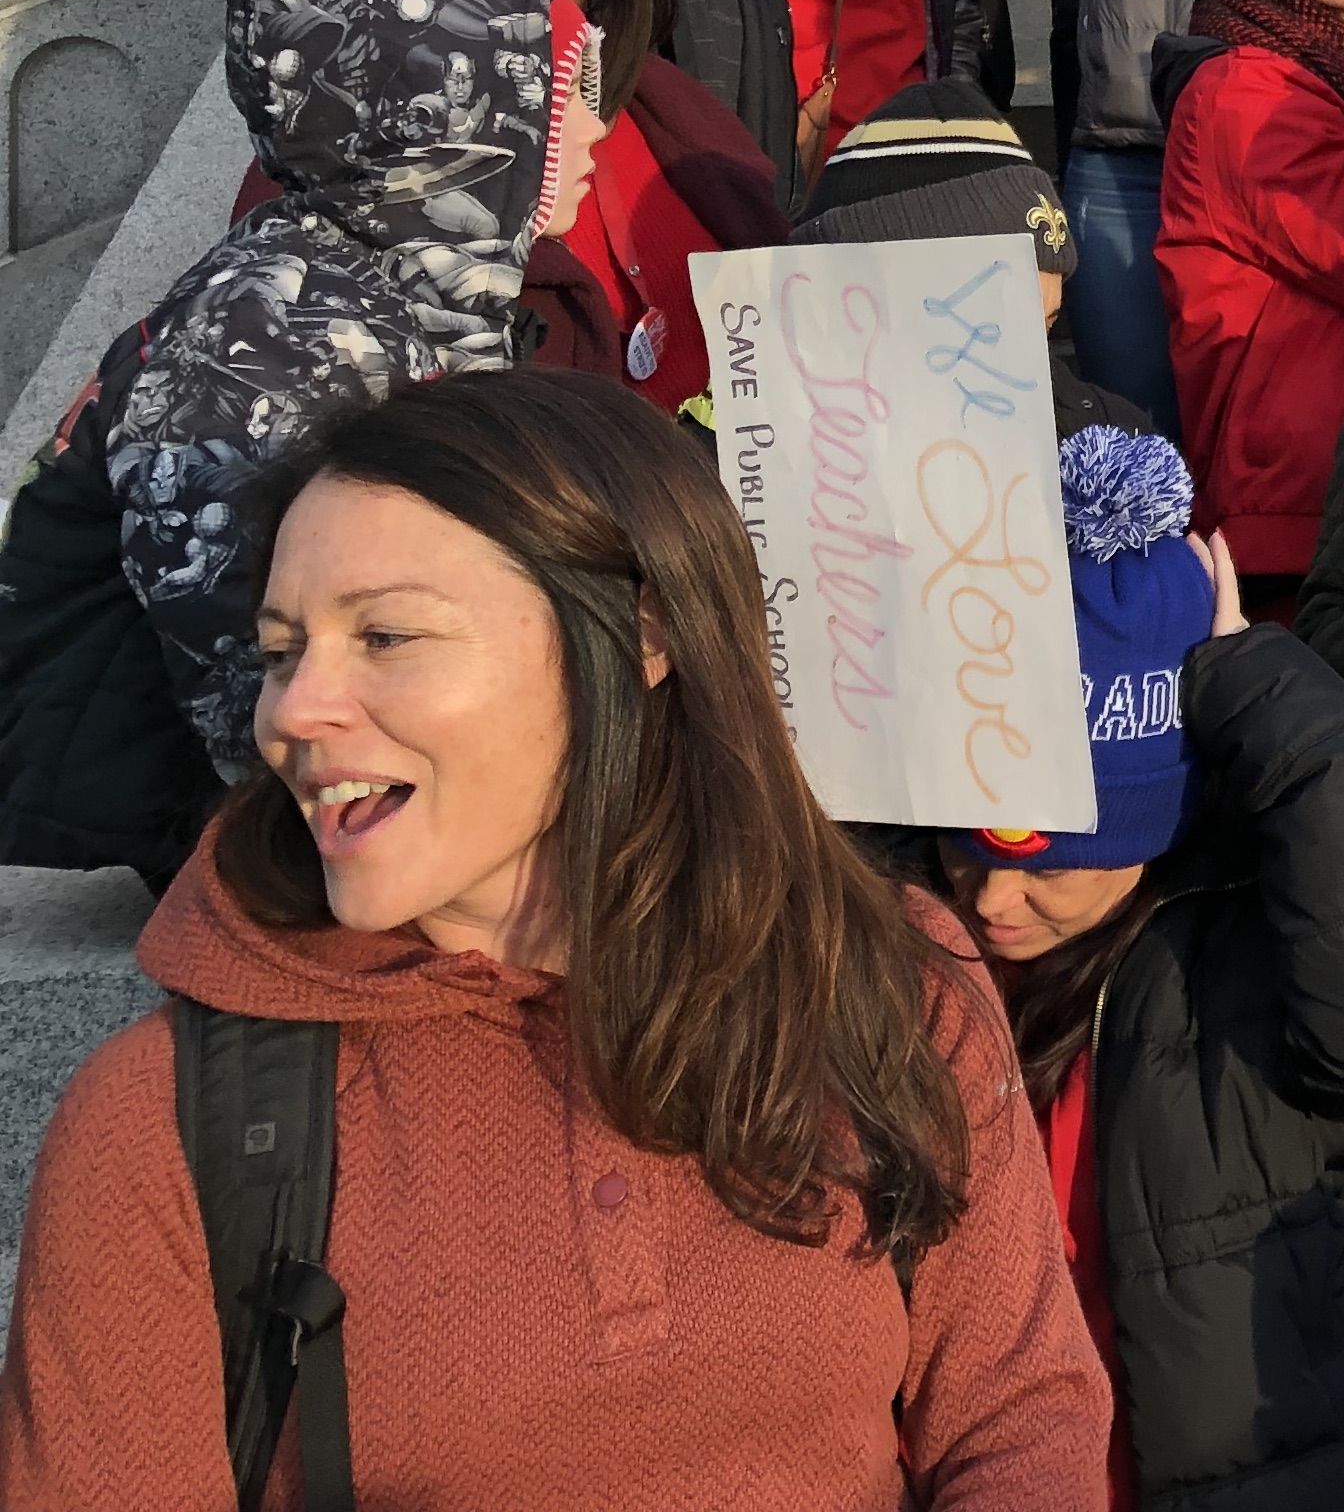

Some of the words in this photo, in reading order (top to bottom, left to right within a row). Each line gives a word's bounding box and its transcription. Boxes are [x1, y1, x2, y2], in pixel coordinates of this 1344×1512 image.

[718, 300, 764, 401] SAVE
[923, 259, 1039, 430] We
[915, 436, 1053, 807] Love
